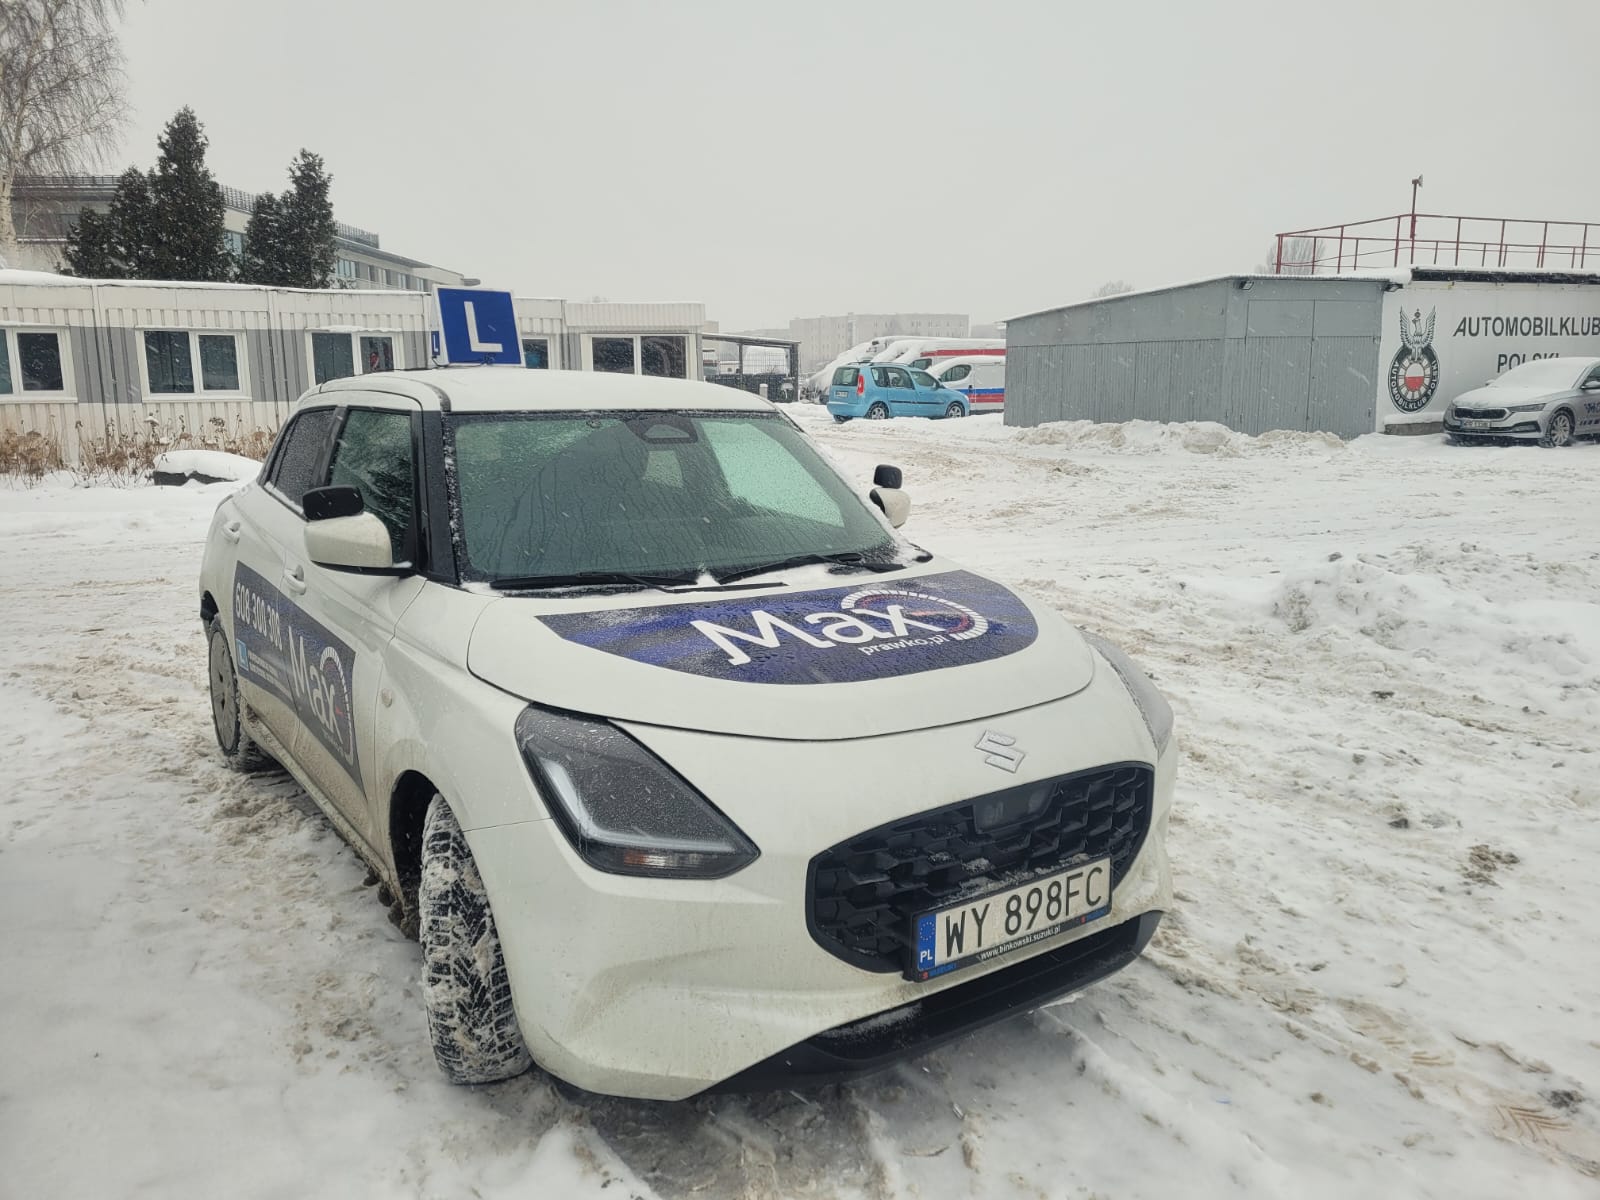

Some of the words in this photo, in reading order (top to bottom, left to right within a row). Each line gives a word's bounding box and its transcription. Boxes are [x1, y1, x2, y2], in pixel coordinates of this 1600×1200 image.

[464, 301, 503, 352] L
[1453, 316, 1600, 337] AUTOMOBILKLUB
[236, 582, 250, 625] 608
[690, 604, 946, 665] Max
[858, 634, 950, 655] prawko.pl
[288, 625, 343, 744] Max
[945, 903, 990, 957] WY
[1005, 866, 1103, 935] 898FC
[920, 949, 933, 963] PL
[980, 926, 1061, 960] www.binkowski.suzuki.pl
